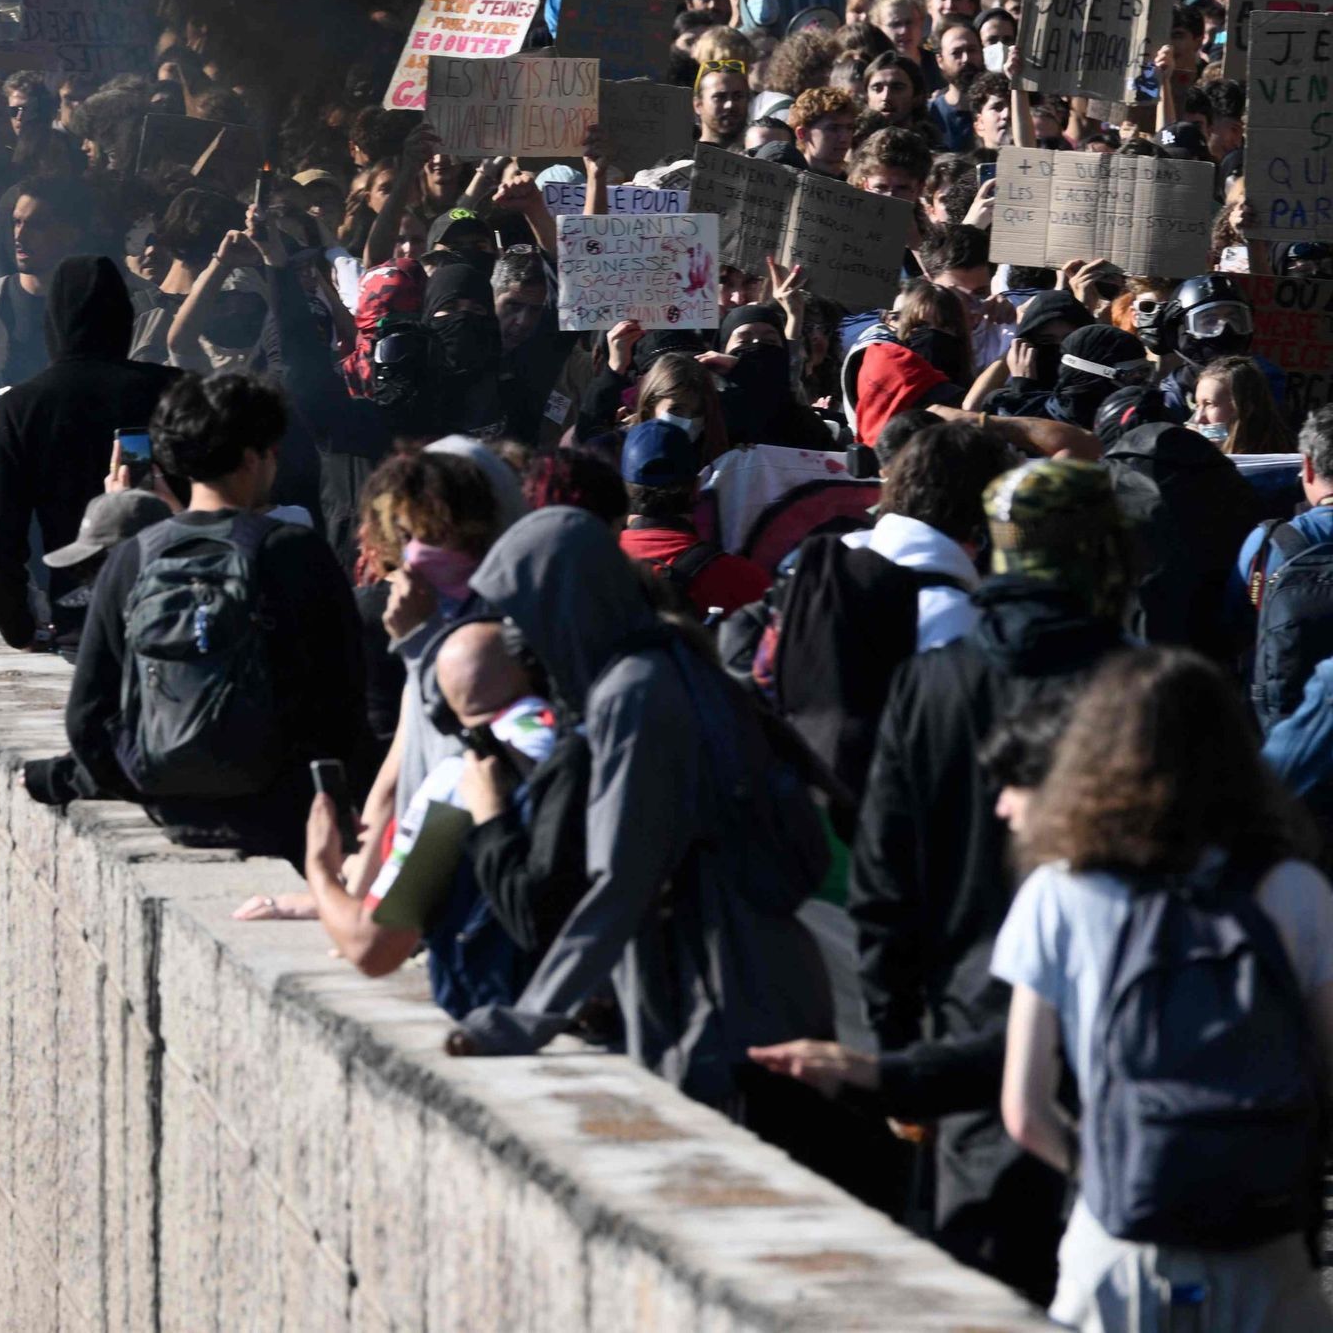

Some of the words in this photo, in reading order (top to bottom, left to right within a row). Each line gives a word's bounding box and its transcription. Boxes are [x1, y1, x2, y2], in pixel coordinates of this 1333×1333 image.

[431, 16, 466, 31] POUR
[429, 59, 473, 97] LES
[480, 59, 543, 101] NAZIS
[547, 59, 598, 98] AUSSI
[521, 103, 546, 151] LES
[632, 189, 680, 213] POUR
[1007, 182, 1033, 200] LES
[562, 215, 699, 237] ETUDIANTS
[1002, 208, 1035, 226] QUE
[1146, 214, 1208, 237] STYLOS
[561, 256, 674, 274] JEUNESSE
[1250, 570, 1262, 606] Canon
